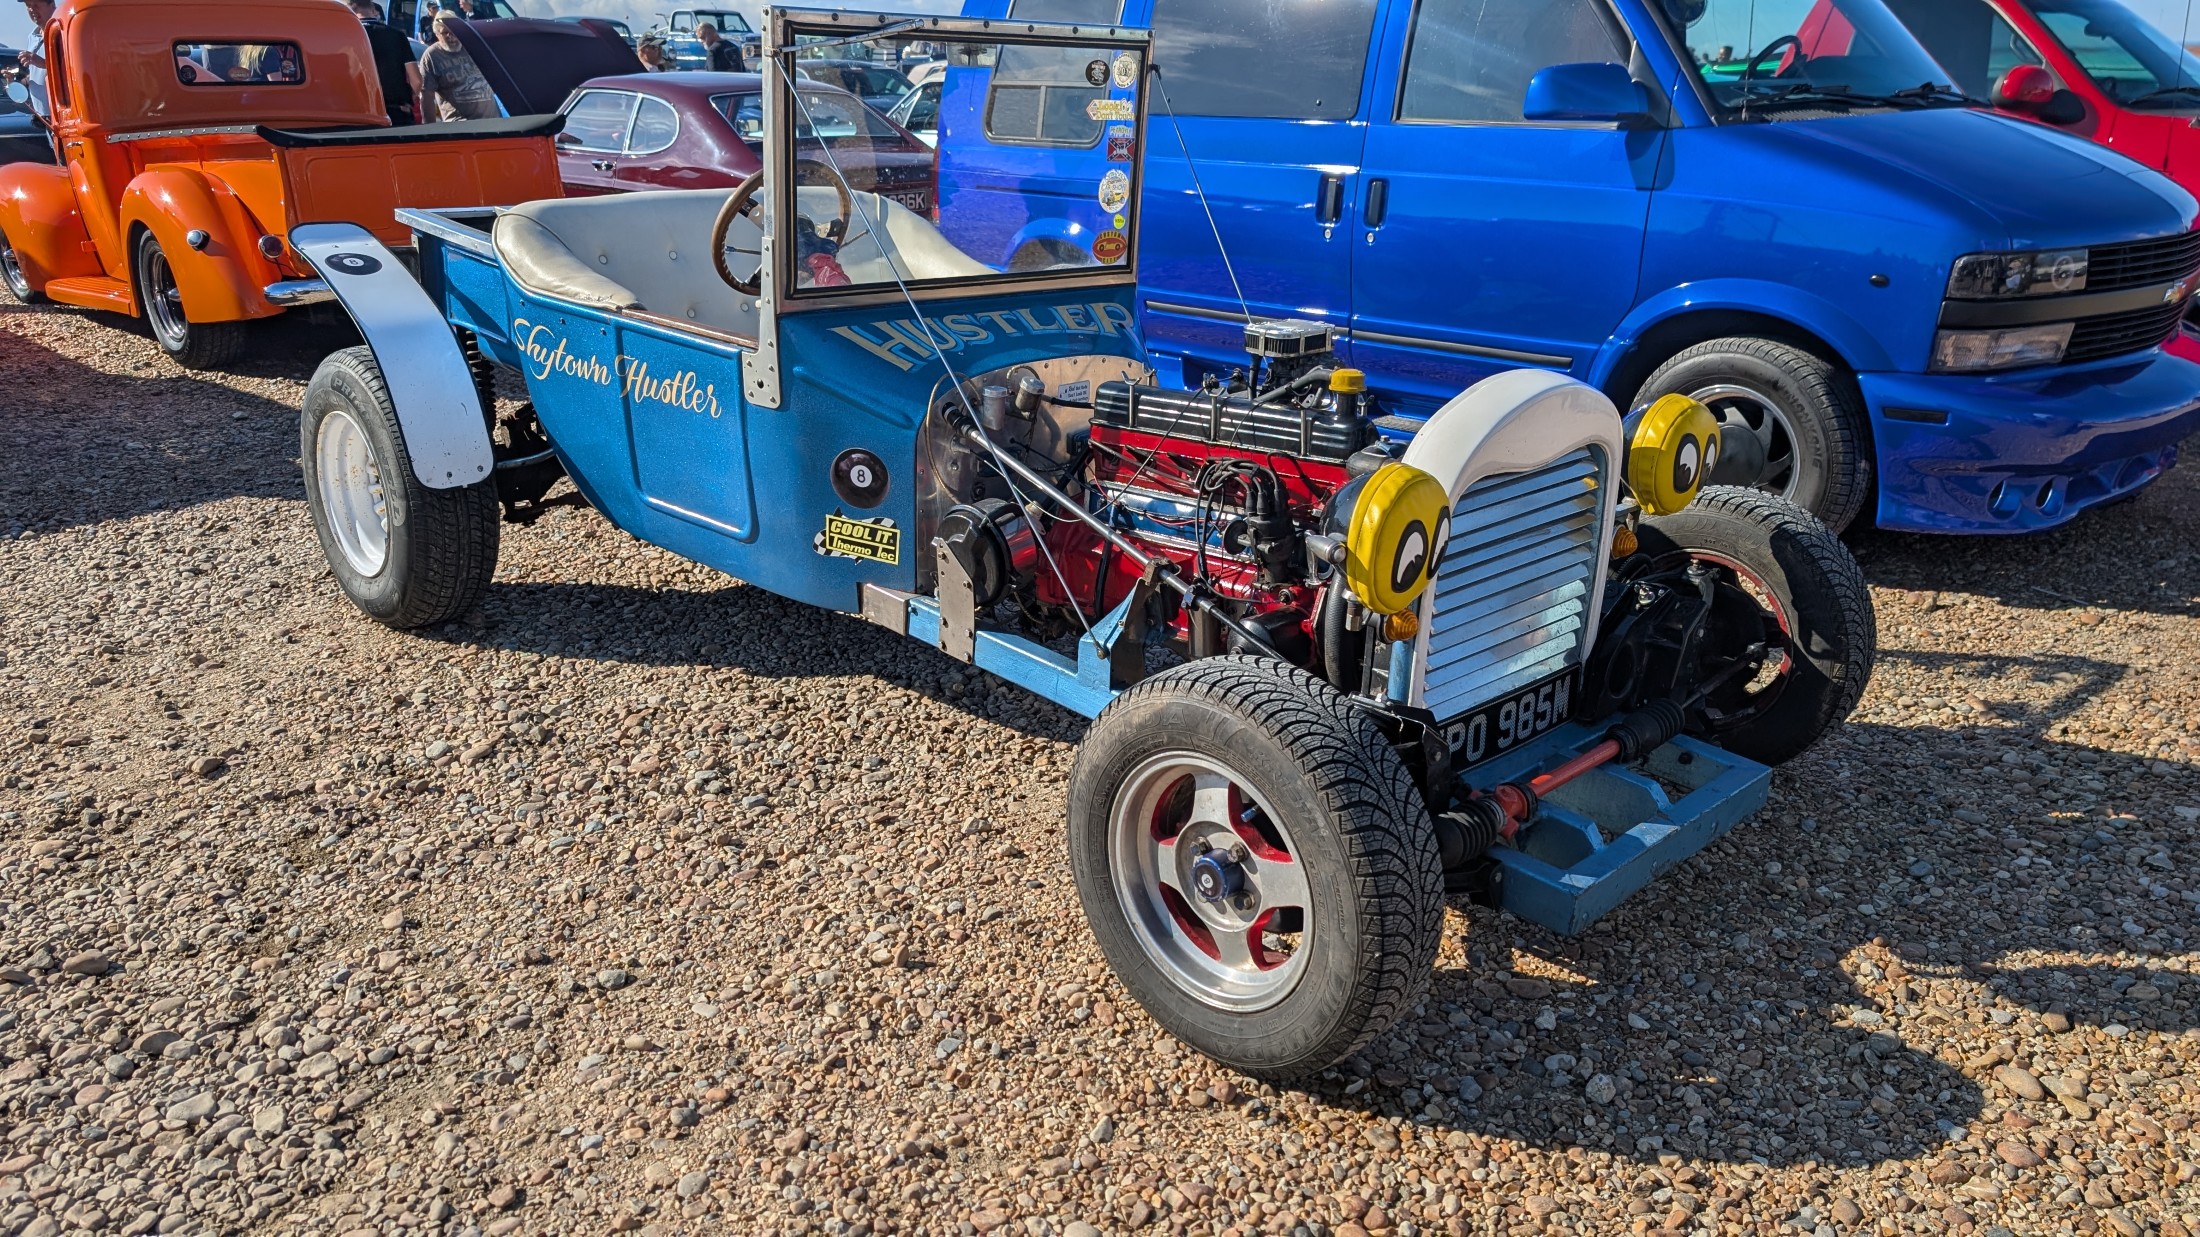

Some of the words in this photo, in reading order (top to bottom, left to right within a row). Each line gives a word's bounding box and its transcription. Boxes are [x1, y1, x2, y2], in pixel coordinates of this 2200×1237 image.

[826, 302, 1134, 372] HUSTLER
[514, 317, 611, 385] Skytown
[614, 354, 722, 419] Hustler
[857, 469, 866, 483] 8
[830, 533, 872, 555] Thermo
[876, 545, 895, 561] Tec
[831, 521, 872, 540] COOL
[1440, 713, 1488, 762] PO
[1497, 674, 1571, 749] 985M
